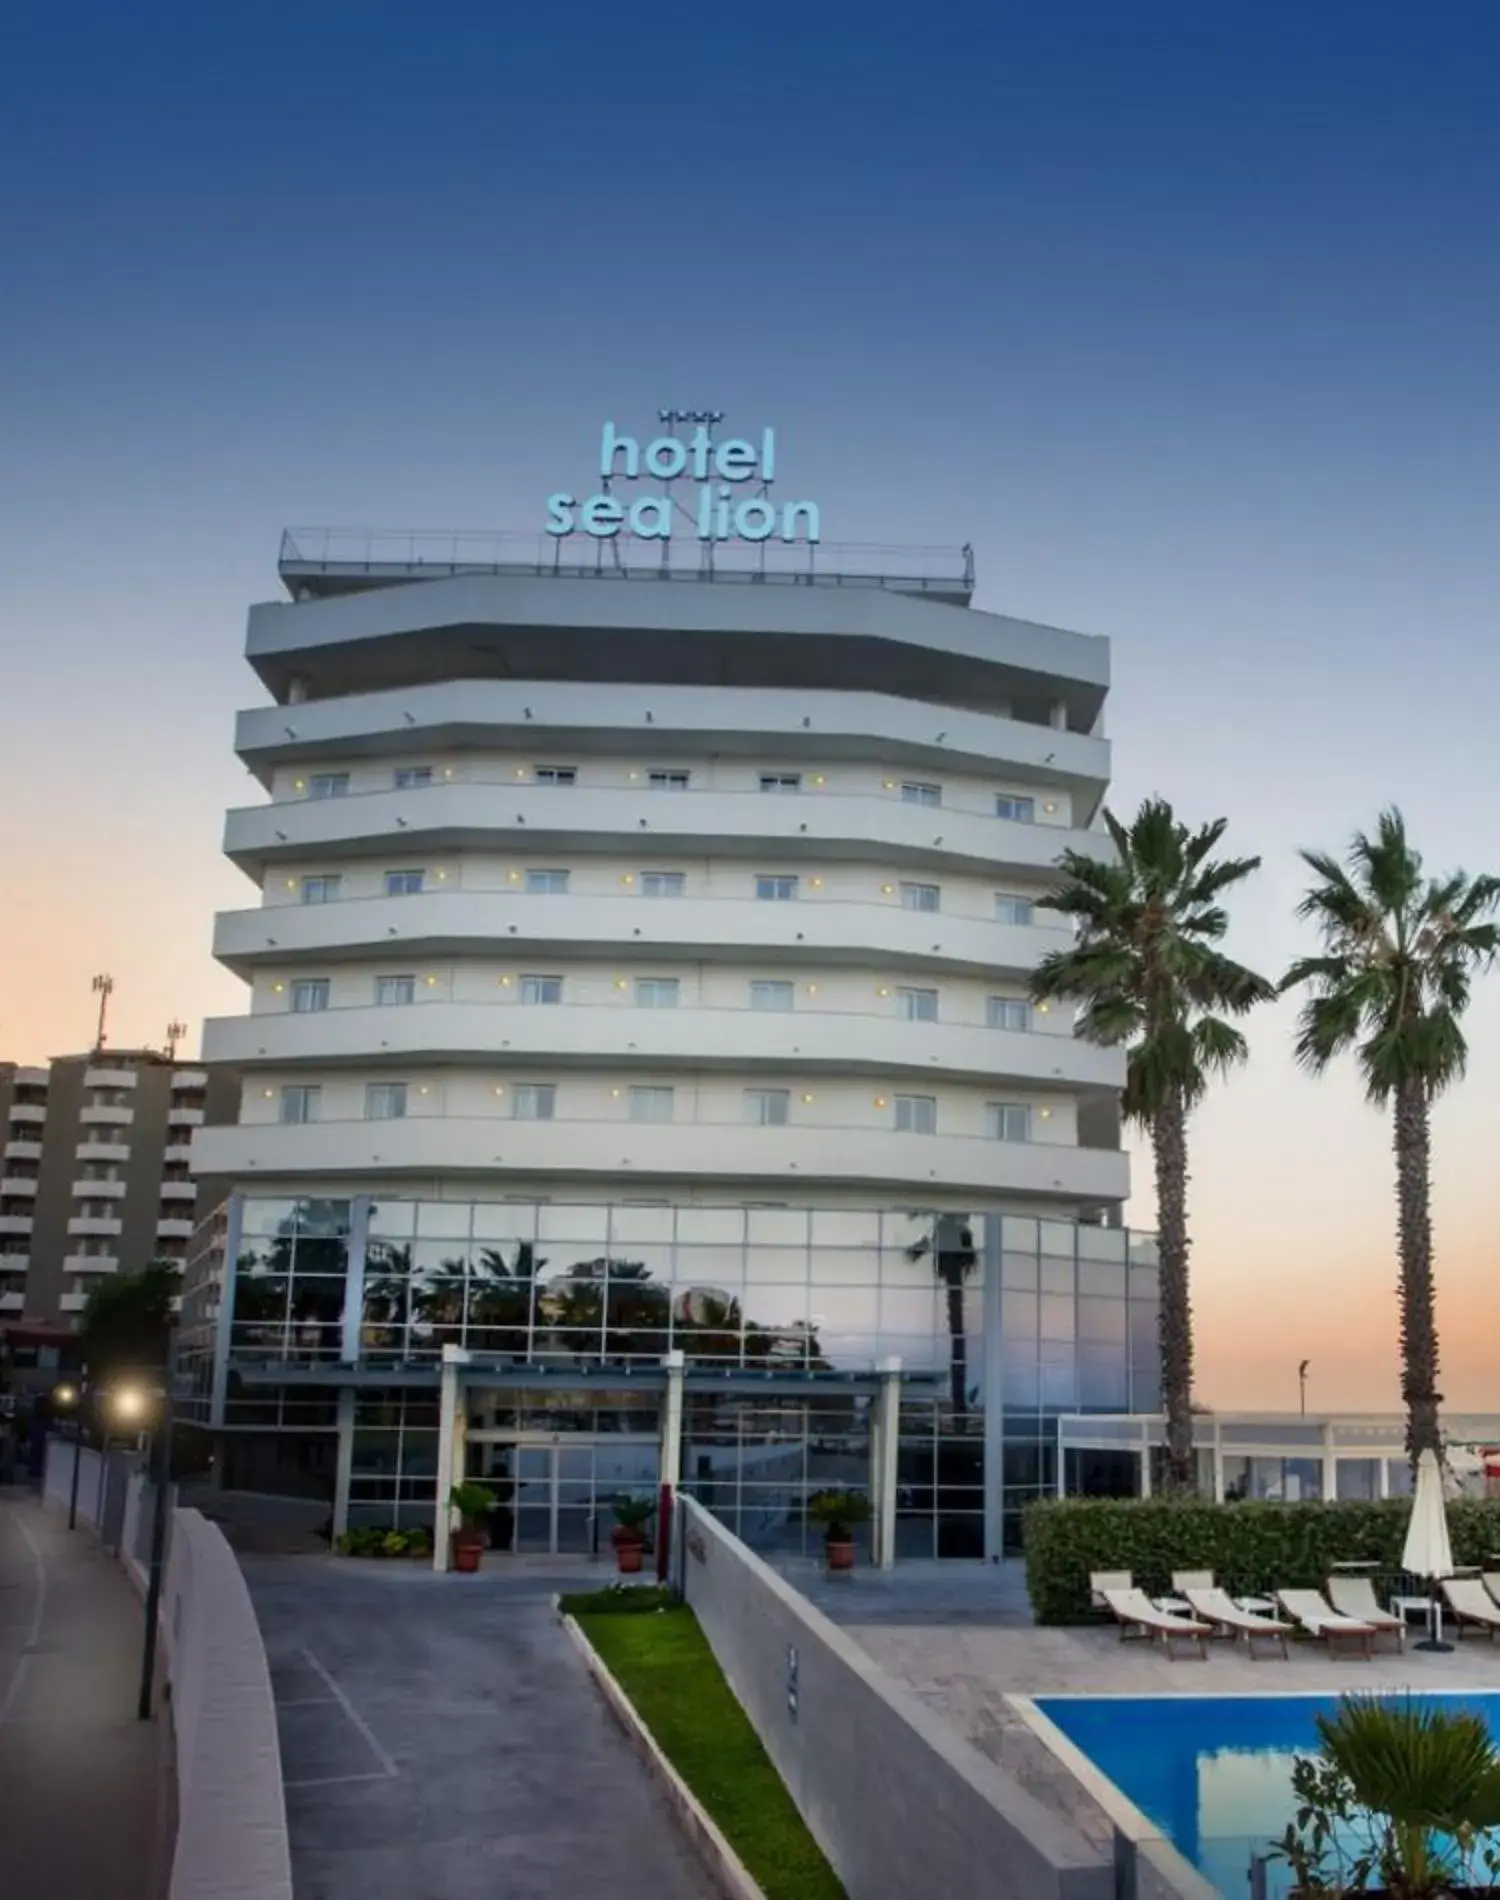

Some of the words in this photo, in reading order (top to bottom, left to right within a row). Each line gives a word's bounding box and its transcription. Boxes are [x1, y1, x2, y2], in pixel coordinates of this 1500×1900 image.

[601, 420, 775, 481] hotel
[545, 492, 671, 539] sea
[698, 483, 820, 542] lion
